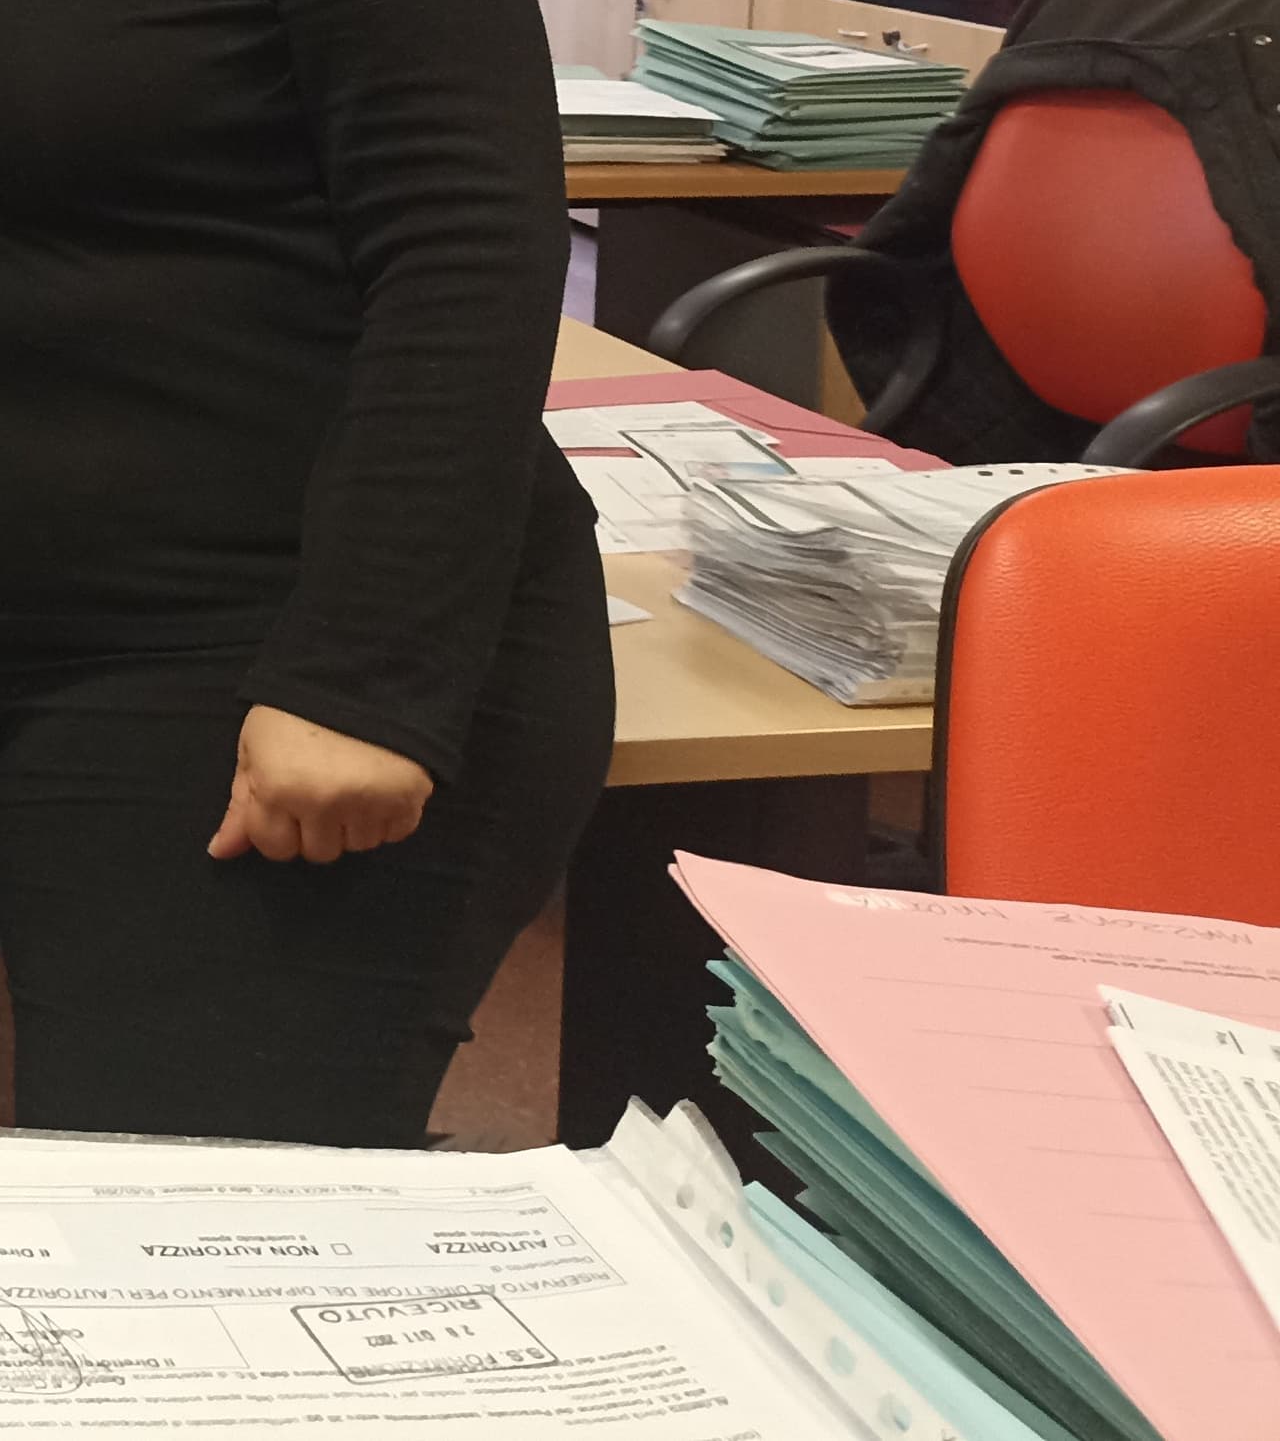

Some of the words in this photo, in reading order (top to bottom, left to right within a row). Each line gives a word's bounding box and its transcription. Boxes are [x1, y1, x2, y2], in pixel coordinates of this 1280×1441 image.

[139, 1243, 263, 1257] AUTORIZZA
[268, 1243, 319, 1257] NON
[424, 1238, 548, 1255] AUTORIZZA
[474, 1282, 497, 1296] AL
[500, 1271, 611, 1295] RISERVATO
[129, 1288, 168, 1300] PER
[173, 1285, 314, 1300] DIPARTIMENTO
[320, 1285, 354, 1299] DEL
[362, 1283, 468, 1298] DIRETTORE
[317, 1297, 483, 1325] RICEVUTO
